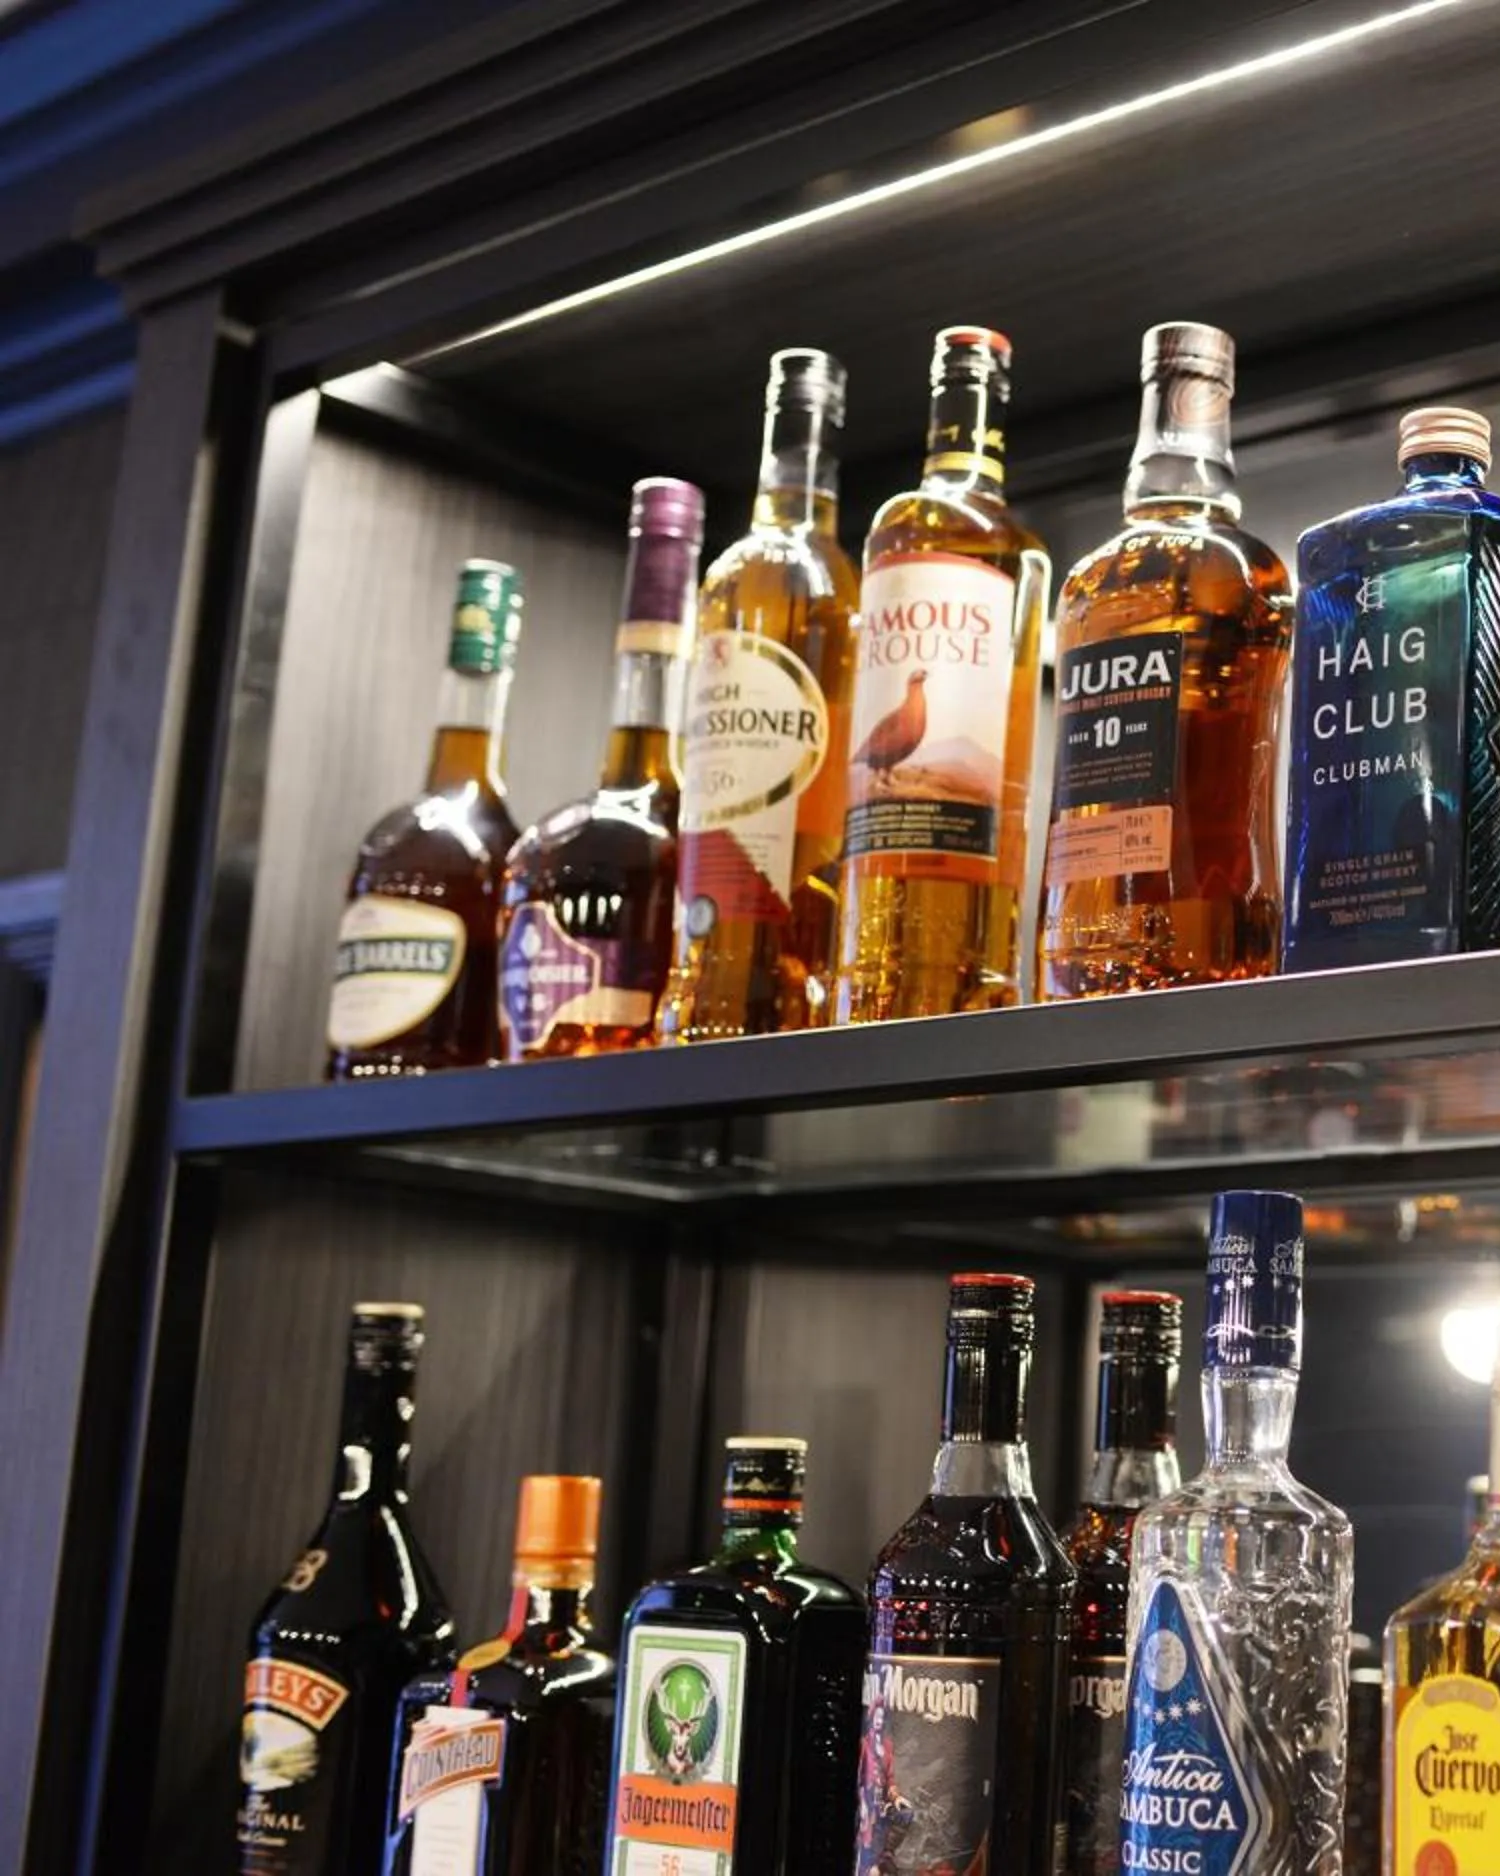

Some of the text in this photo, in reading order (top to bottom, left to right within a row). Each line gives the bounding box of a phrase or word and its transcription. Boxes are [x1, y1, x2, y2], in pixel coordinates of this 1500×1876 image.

[1061, 649, 1173, 701] JURA
[1317, 626, 1427, 681] HAIG
[1093, 715, 1122, 749] 10
[1312, 687, 1428, 740] CLUB
[1312, 751, 1426, 786] CLUBMAN
[880, 1662, 979, 1722] Morgan
[1121, 1742, 1224, 1793] Antica
[1122, 1839, 1201, 1875] CLASSIC
